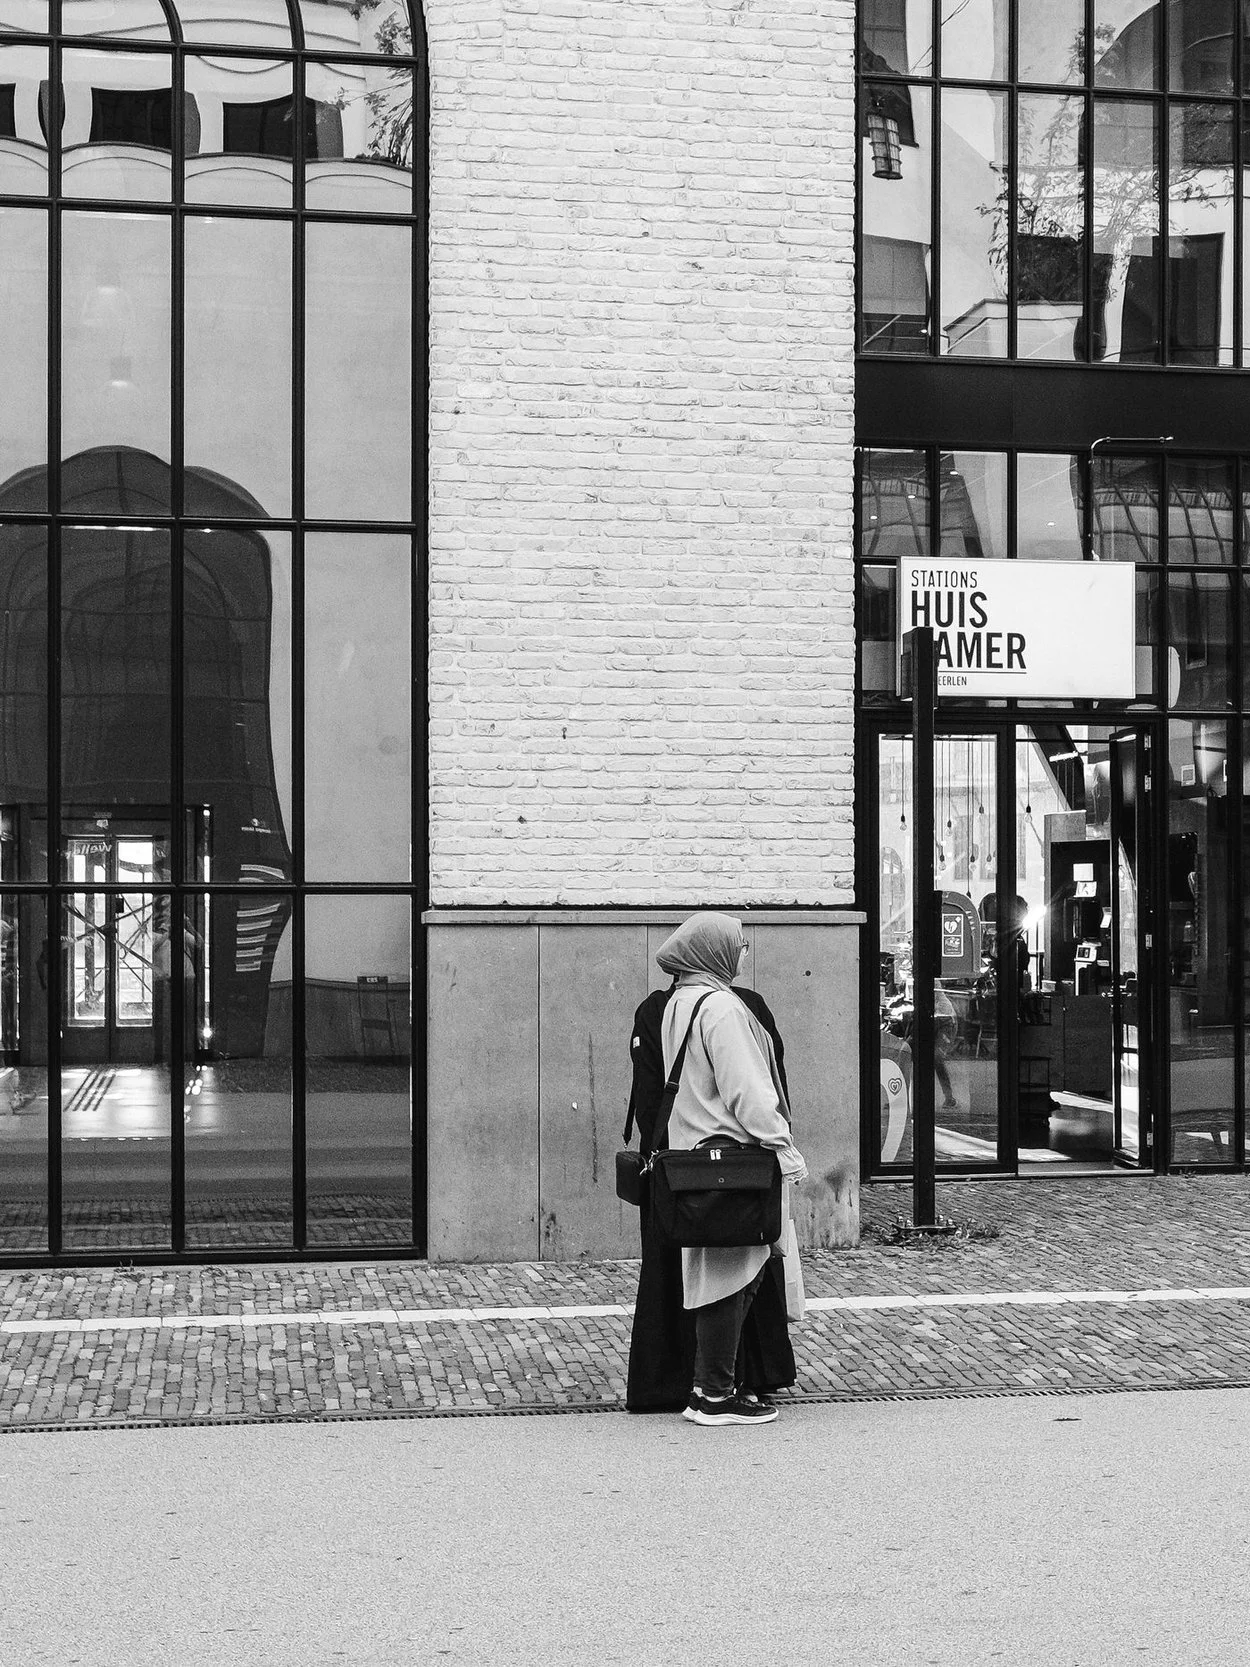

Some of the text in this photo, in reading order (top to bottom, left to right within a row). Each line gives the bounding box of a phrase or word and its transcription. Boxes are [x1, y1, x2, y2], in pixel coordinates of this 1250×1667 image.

[911, 569, 978, 588] STATIONS
[911, 590, 988, 628] HUIS
[934, 631, 1027, 669] AMER
[937, 675, 967, 686] EERLEN
